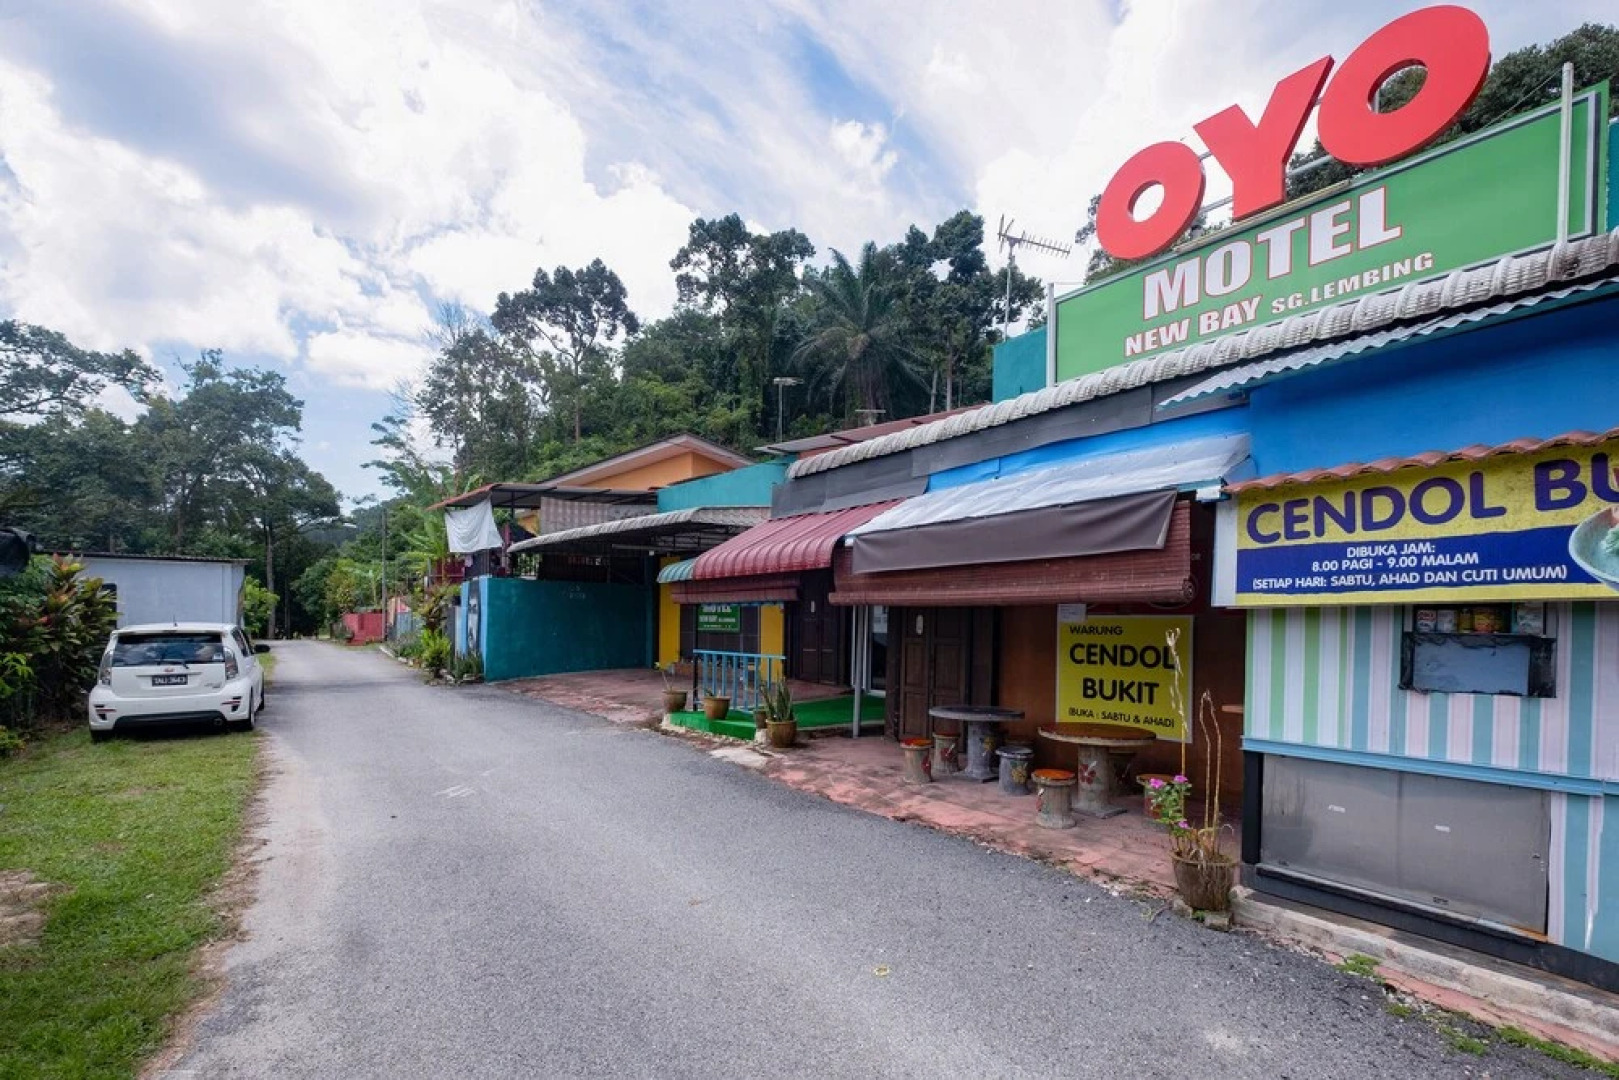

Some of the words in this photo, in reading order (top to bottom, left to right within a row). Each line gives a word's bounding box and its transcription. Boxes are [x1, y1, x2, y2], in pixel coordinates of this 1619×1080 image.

[1096, 4, 1491, 260] OYO
[1143, 185, 1402, 321] MOTEL
[1124, 317, 1191, 357] NEW
[1198, 294, 1263, 336] BAY
[1271, 252, 1434, 314] SG.LEMBING
[1246, 471, 1507, 545] CENDOL
[1312, 560, 1338, 573] 8.00
[1341, 557, 1374, 571] PAGI
[1388, 556, 1417, 569] 9.00
[1421, 552, 1479, 567] MALAM
[1346, 544, 1397, 558] DIBUKA
[1401, 541, 1436, 555] JAM:
[1252, 577, 1293, 590] (SETIAP
[1295, 575, 1327, 588] HARI:
[1330, 573, 1376, 587] SABTU,
[1378, 571, 1420, 586] AHAD
[1424, 570, 1458, 584] DAN
[1461, 568, 1498, 582] CUTI
[1503, 564, 1568, 581] UMUM)
[1069, 625, 1123, 636] WARUNG
[1069, 643, 1177, 670] CENDOL
[1082, 677, 1160, 705] BUKIT
[1101, 710, 1131, 723] SABTU
